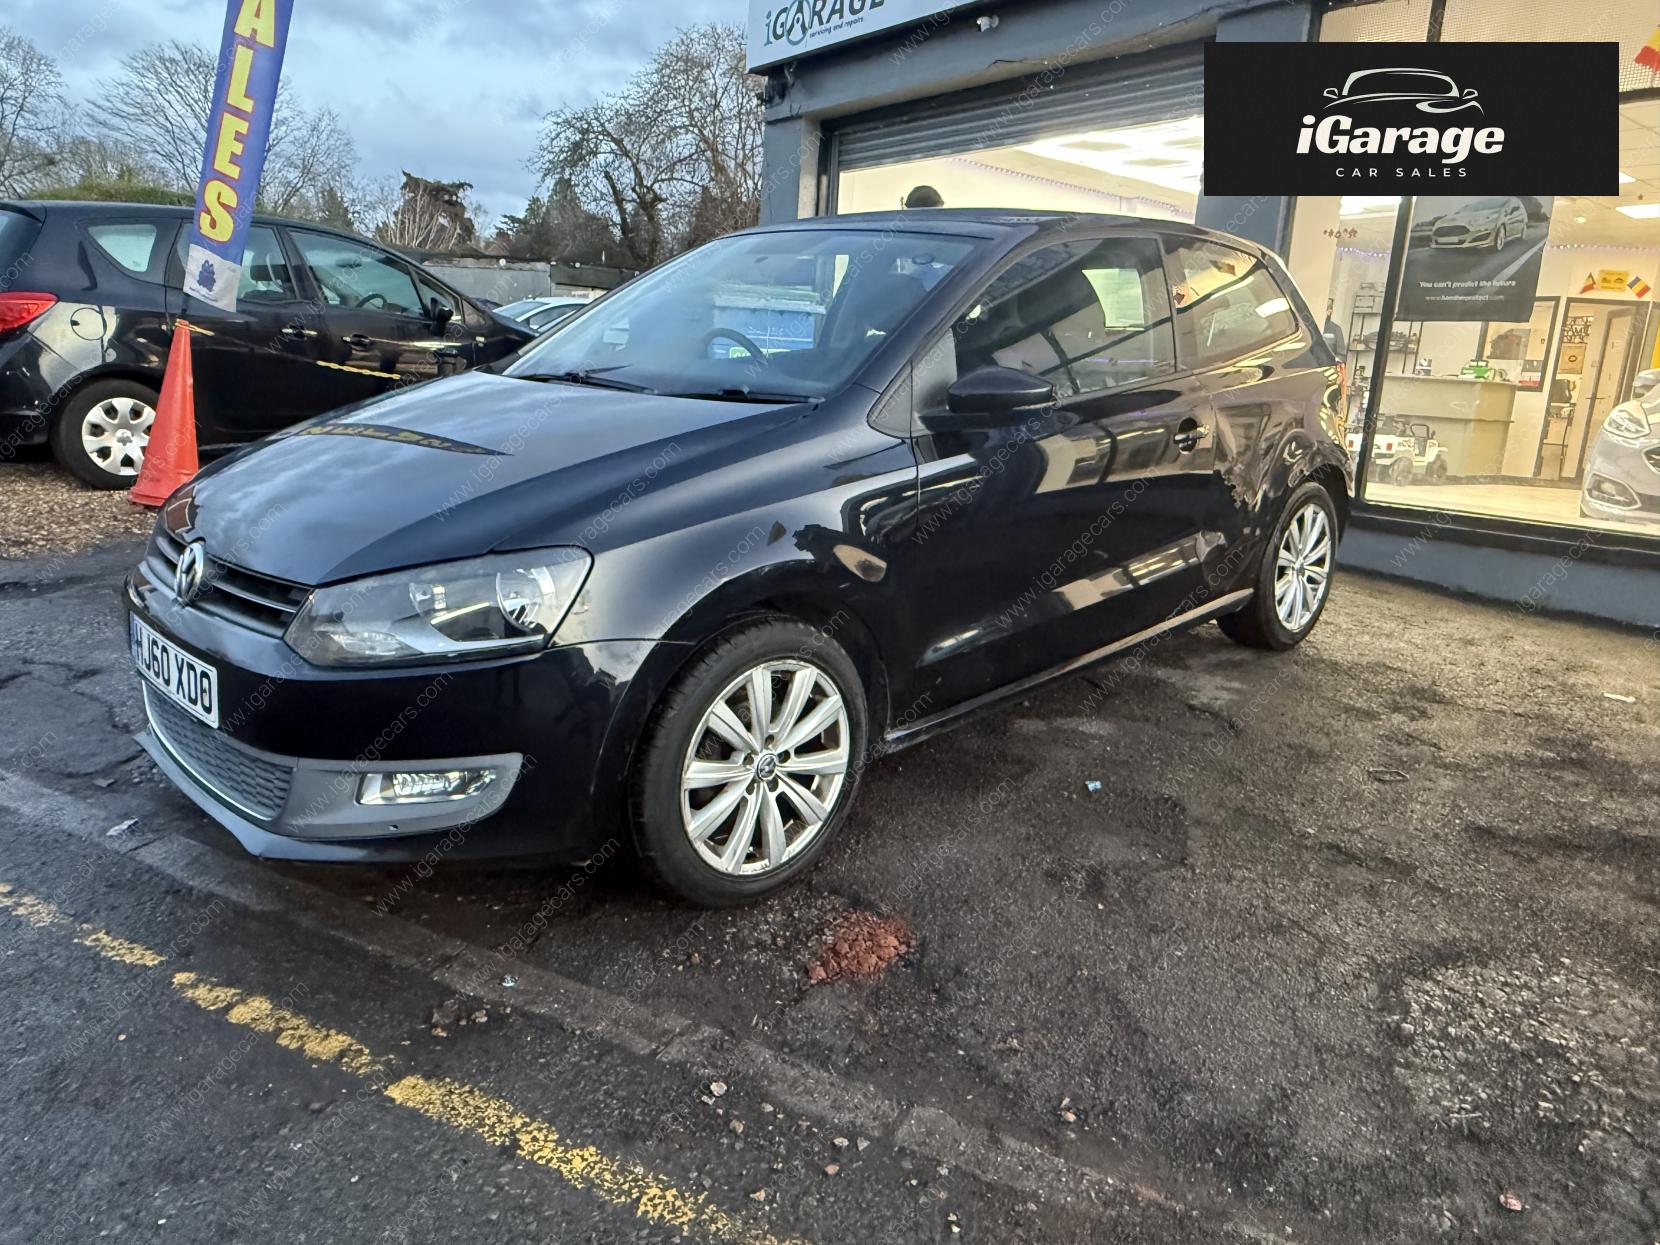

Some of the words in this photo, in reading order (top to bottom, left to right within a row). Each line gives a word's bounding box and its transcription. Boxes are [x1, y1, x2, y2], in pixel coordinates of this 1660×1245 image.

[832, 20, 844, 32] and
[1433, 281, 1452, 289] can't
[1452, 281, 1478, 289] predict
[1479, 280, 1492, 288] the
[1492, 280, 1516, 288] future
[135, 622, 170, 688] HJ60
